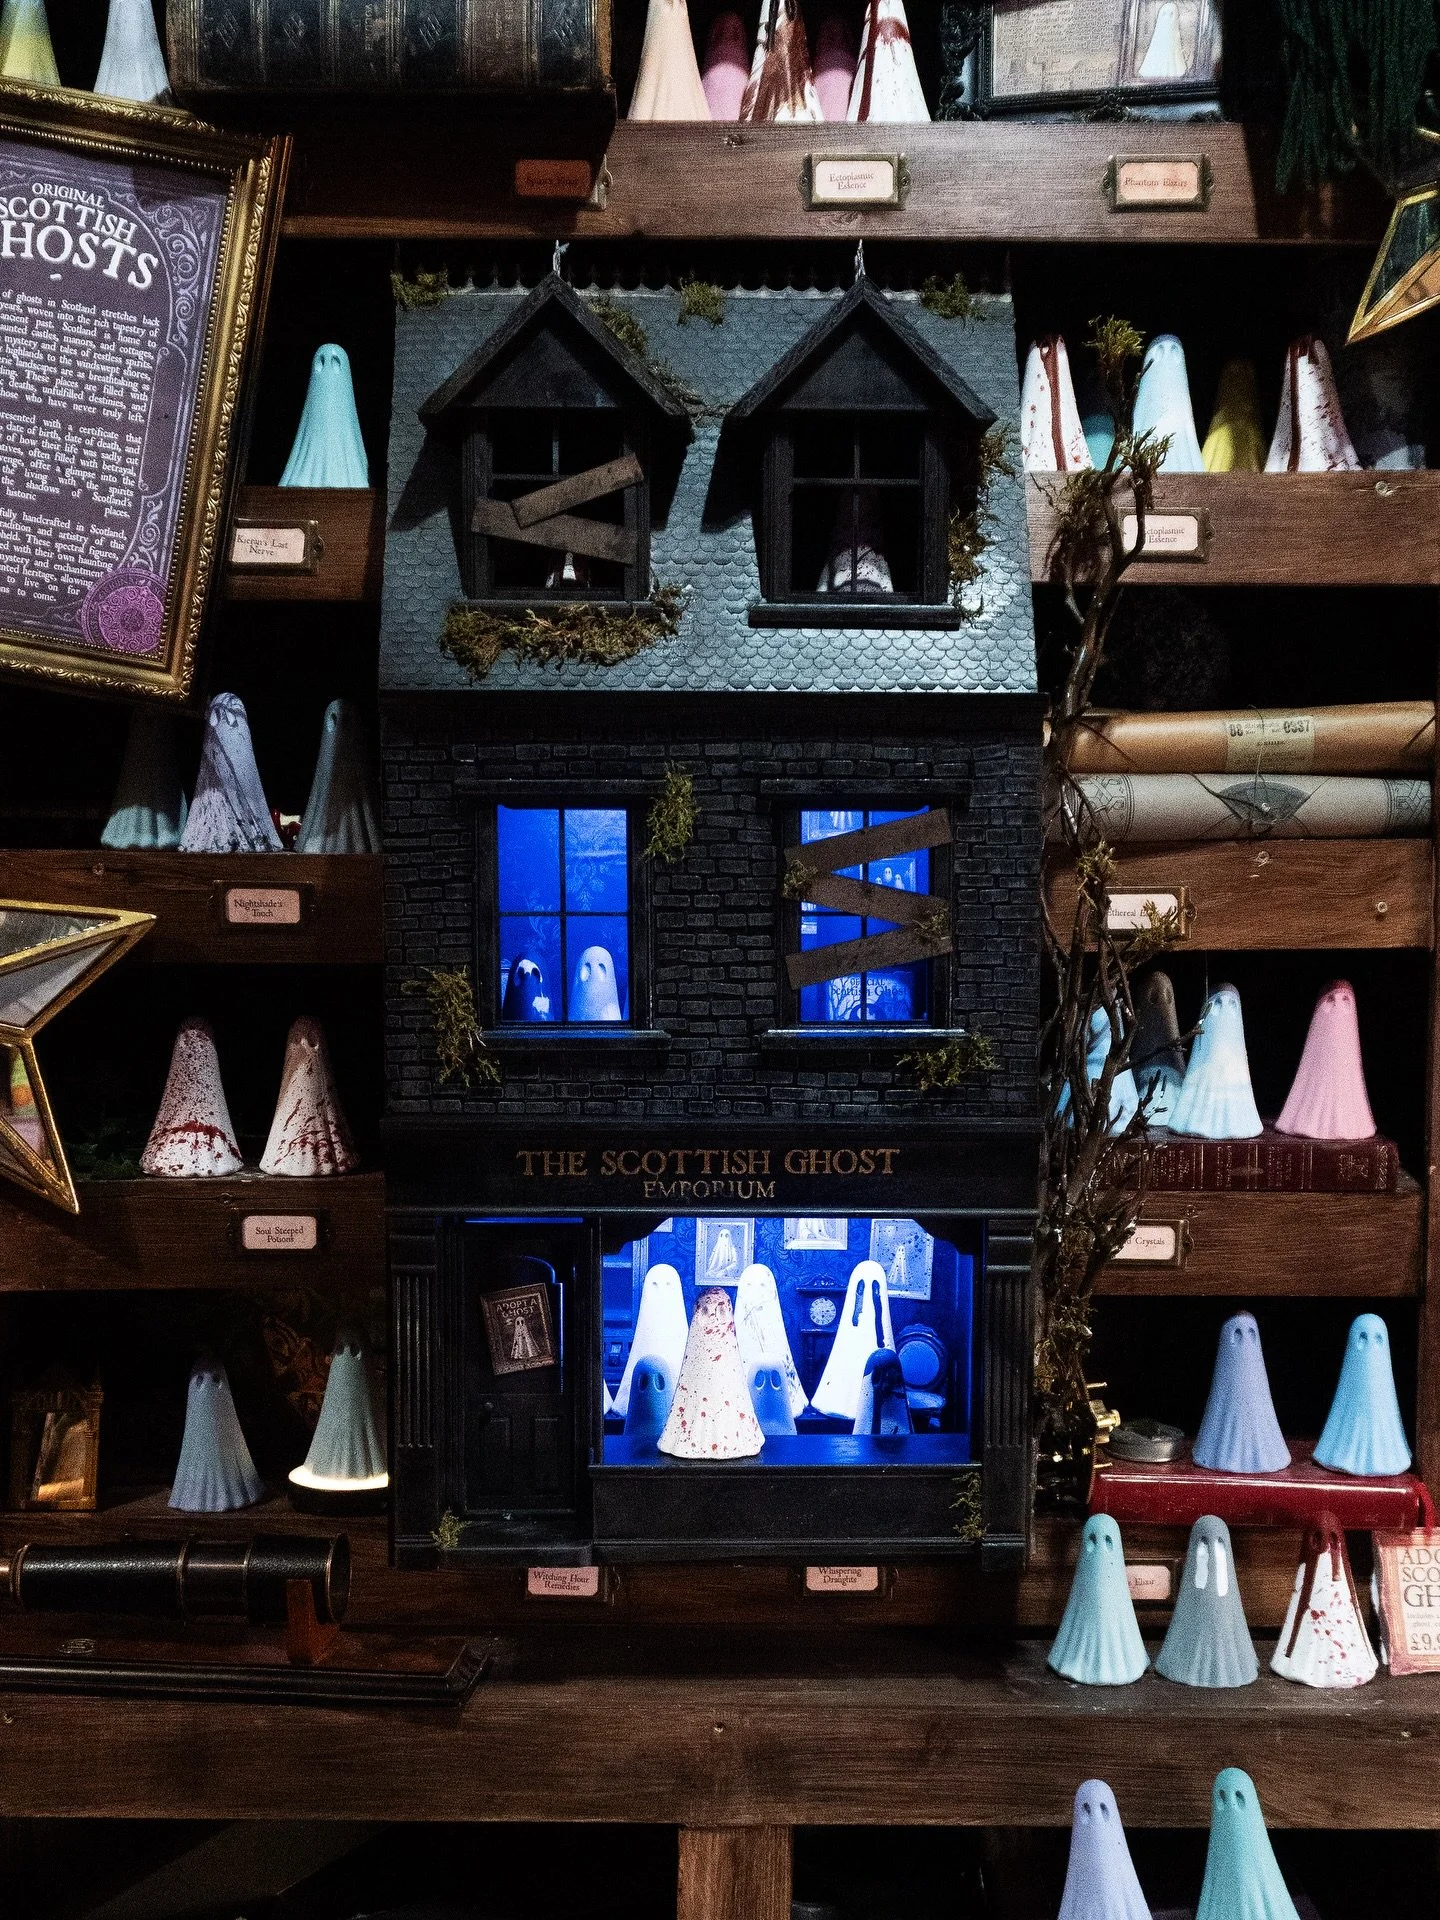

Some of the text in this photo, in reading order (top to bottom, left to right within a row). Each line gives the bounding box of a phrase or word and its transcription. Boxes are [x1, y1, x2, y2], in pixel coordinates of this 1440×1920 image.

[838, 181, 867, 190] Essence
[1125, 177, 1159, 187] Phantom
[32, 182, 106, 208] ORIGINAL
[2, 289, 159, 326] of ghosts in Scotland stretches back
[28, 307, 159, 338] woven into the rich tapestry of
[62, 321, 156, 347] Scotland is home to
[5, 336, 122, 363] mystery and tales of restless
[100, 341, 115, 351] and
[6, 344, 44, 359] highlands
[48, 353, 56, 361] to
[60, 354, 72, 364] the
[76, 358, 120, 376] windswept
[16, 356, 58, 375] landscapes
[60, 368, 73, 376] are
[89, 371, 138, 393] breathtaking
[25, 369, 50, 382] These
[56, 376, 78, 388] places
[103, 384, 124, 397] filled
[130, 390, 148, 401] with
[26, 392, 42, 402] who
[48, 395, 67, 407] have
[73, 403, 97, 413] never
[103, 407, 122, 421] truly
[42, 385, 84, 400] unfulfilled
[132, 402, 146, 412] and
[6, 421, 24, 433] date
[27, 426, 38, 435] of
[65, 432, 82, 443] date
[85, 437, 96, 446] of
[125, 445, 140, 454] and
[43, 417, 142, 443] with certificate that
[7, 433, 139, 465] of how their life was sadly cut
[28, 447, 50, 459] often
[54, 451, 75, 463] filled
[80, 457, 98, 467] with
[2, 464, 134, 497] the living with the spirits
[30, 458, 51, 470] offer
[65, 465, 96, 481] glimpse
[101, 471, 117, 482] into
[122, 476, 135, 486] the
[2, 475, 132, 507] the shadows of Scotland's
[6, 486, 36, 500] historic
[22, 511, 70, 528] handcrafted
[76, 521, 84, 531] in
[37, 526, 124, 549] and artistry of this
[1146, 527, 1185, 536] ctoplasmic
[1149, 534, 1178, 544] Essence
[26, 534, 50, 547] These
[54, 542, 84, 553] spectral
[249, 546, 274, 556] Nerve
[271, 539, 288, 549] Last
[14, 542, 31, 553] with
[35, 546, 54, 558] their
[58, 553, 74, 561] own
[78, 554, 112, 572] haunting
[34, 558, 104, 578] and enchantment
[7, 575, 15, 583] to
[24, 577, 40, 588] live
[68, 585, 80, 595] for
[18, 588, 26, 596] to
[60, 573, 92, 591] allowing
[234, 899, 283, 911] Nightshade's
[516, 1148, 900, 1176] THE SCOTTISH GHOST
[643, 1180, 776, 1199] EMPORIUM
[255, 1226, 304, 1237] Soul Steeped
[1135, 1237, 1165, 1247] Crystals
[496, 1298, 537, 1312] ADOPT A
[501, 1306, 535, 1318] GHOST
[533, 1571, 567, 1584] Witching
[544, 1580, 580, 1591] Remedies
